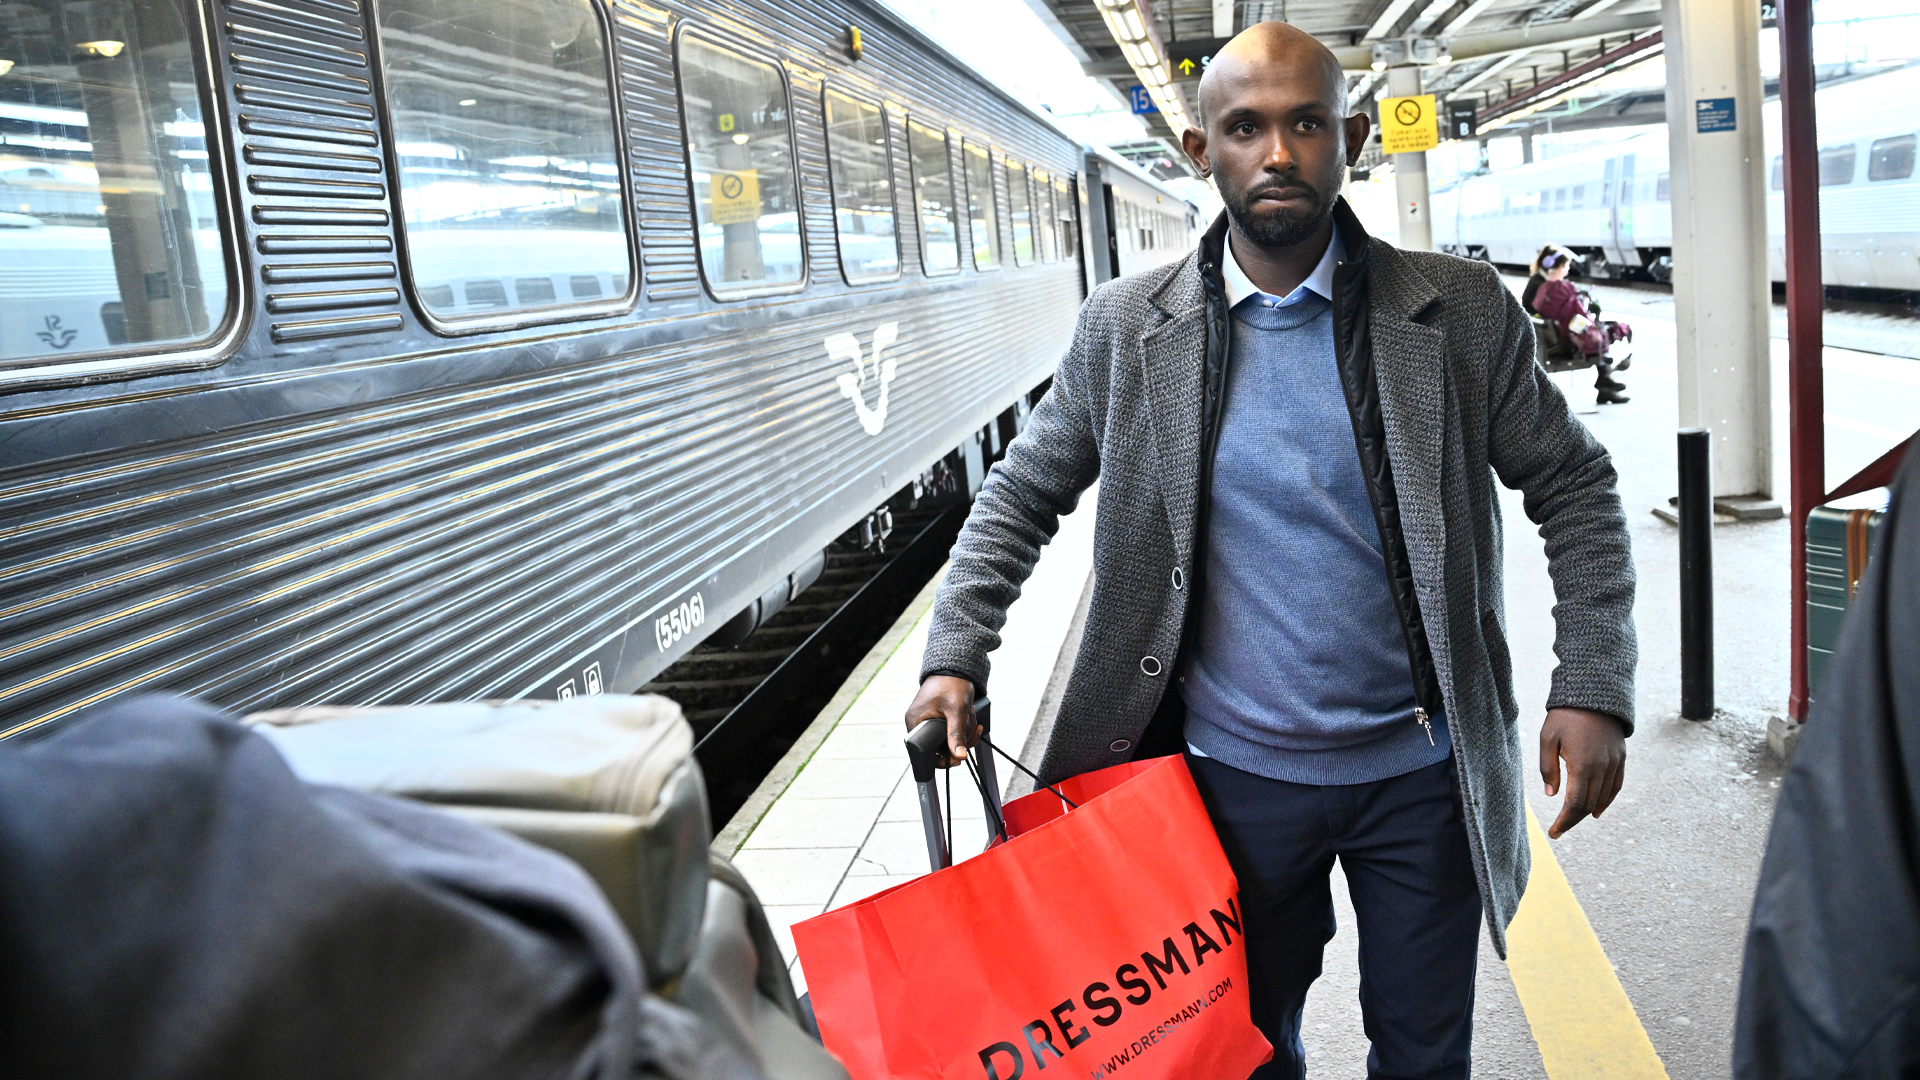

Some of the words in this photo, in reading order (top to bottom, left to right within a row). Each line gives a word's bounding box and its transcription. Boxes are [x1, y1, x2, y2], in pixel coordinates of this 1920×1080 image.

[655, 591, 705, 653] (5506)
[978, 891, 1243, 1080] DRESSMAN
[1090, 976, 1233, 1080] WWW.DRESSMANN.COM
